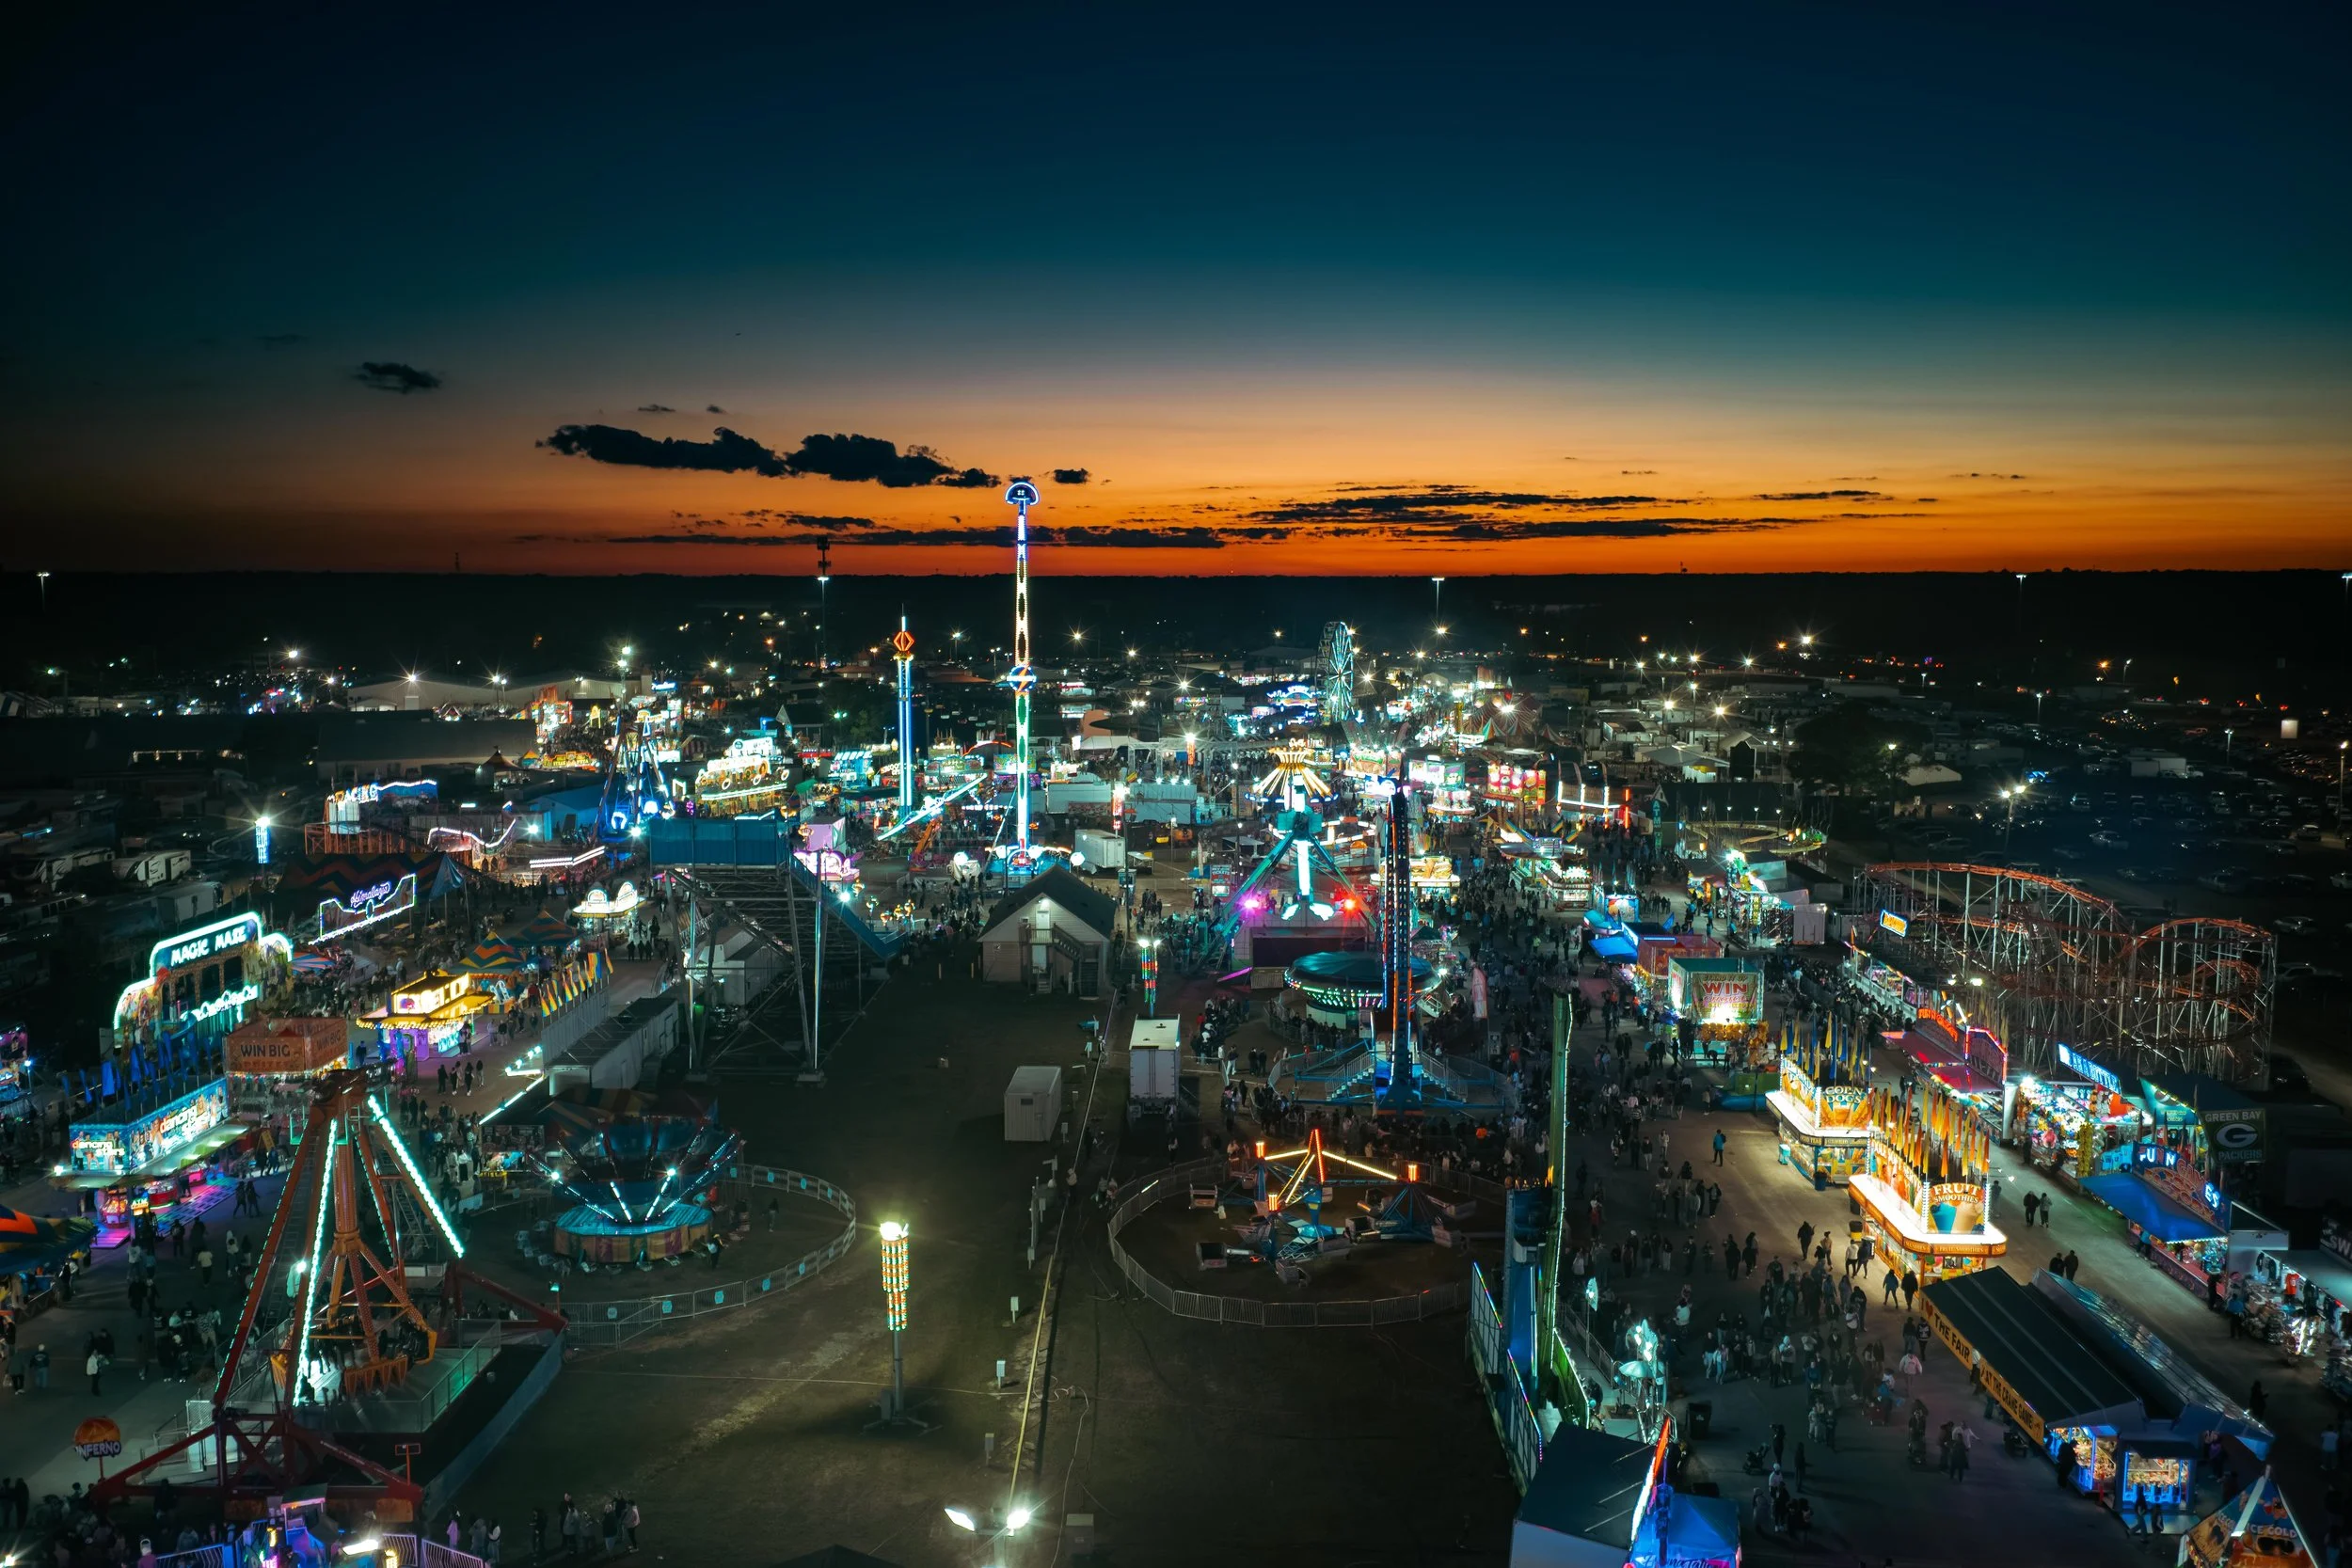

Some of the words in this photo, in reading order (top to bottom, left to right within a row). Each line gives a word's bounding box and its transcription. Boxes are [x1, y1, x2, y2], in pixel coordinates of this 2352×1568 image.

[171, 939, 209, 966] MAGIC
[215, 925, 246, 951] MAZE
[1703, 981, 1748, 995] WIN
[240, 1045, 266, 1057] WIN
[269, 1044, 291, 1057] BIG
[1825, 1085, 1863, 1096] CORN
[1826, 1095, 1861, 1104] DOGS
[2204, 1113, 2239, 1122] GREEN
[2242, 1111, 2262, 1120] BAY
[72, 1140, 113, 1150] dancing
[94, 1147, 125, 1156] stars
[2218, 1149, 2262, 1161] PACKERS
[1933, 1182, 1981, 1196] FRUIT
[1933, 1194, 1979, 1204] SMOOTHIES
[1934, 1313, 1949, 1341] THE
[1951, 1331, 1970, 1363] FAIR
[1985, 1370, 1993, 1385] AT
[1993, 1376, 2001, 1395] THE
[2002, 1386, 2017, 1414] CRANE
[2018, 1401, 2033, 1429] GAME
[75, 1441, 119, 1455] INFERNO
[2268, 1526, 2297, 1538] COLD
